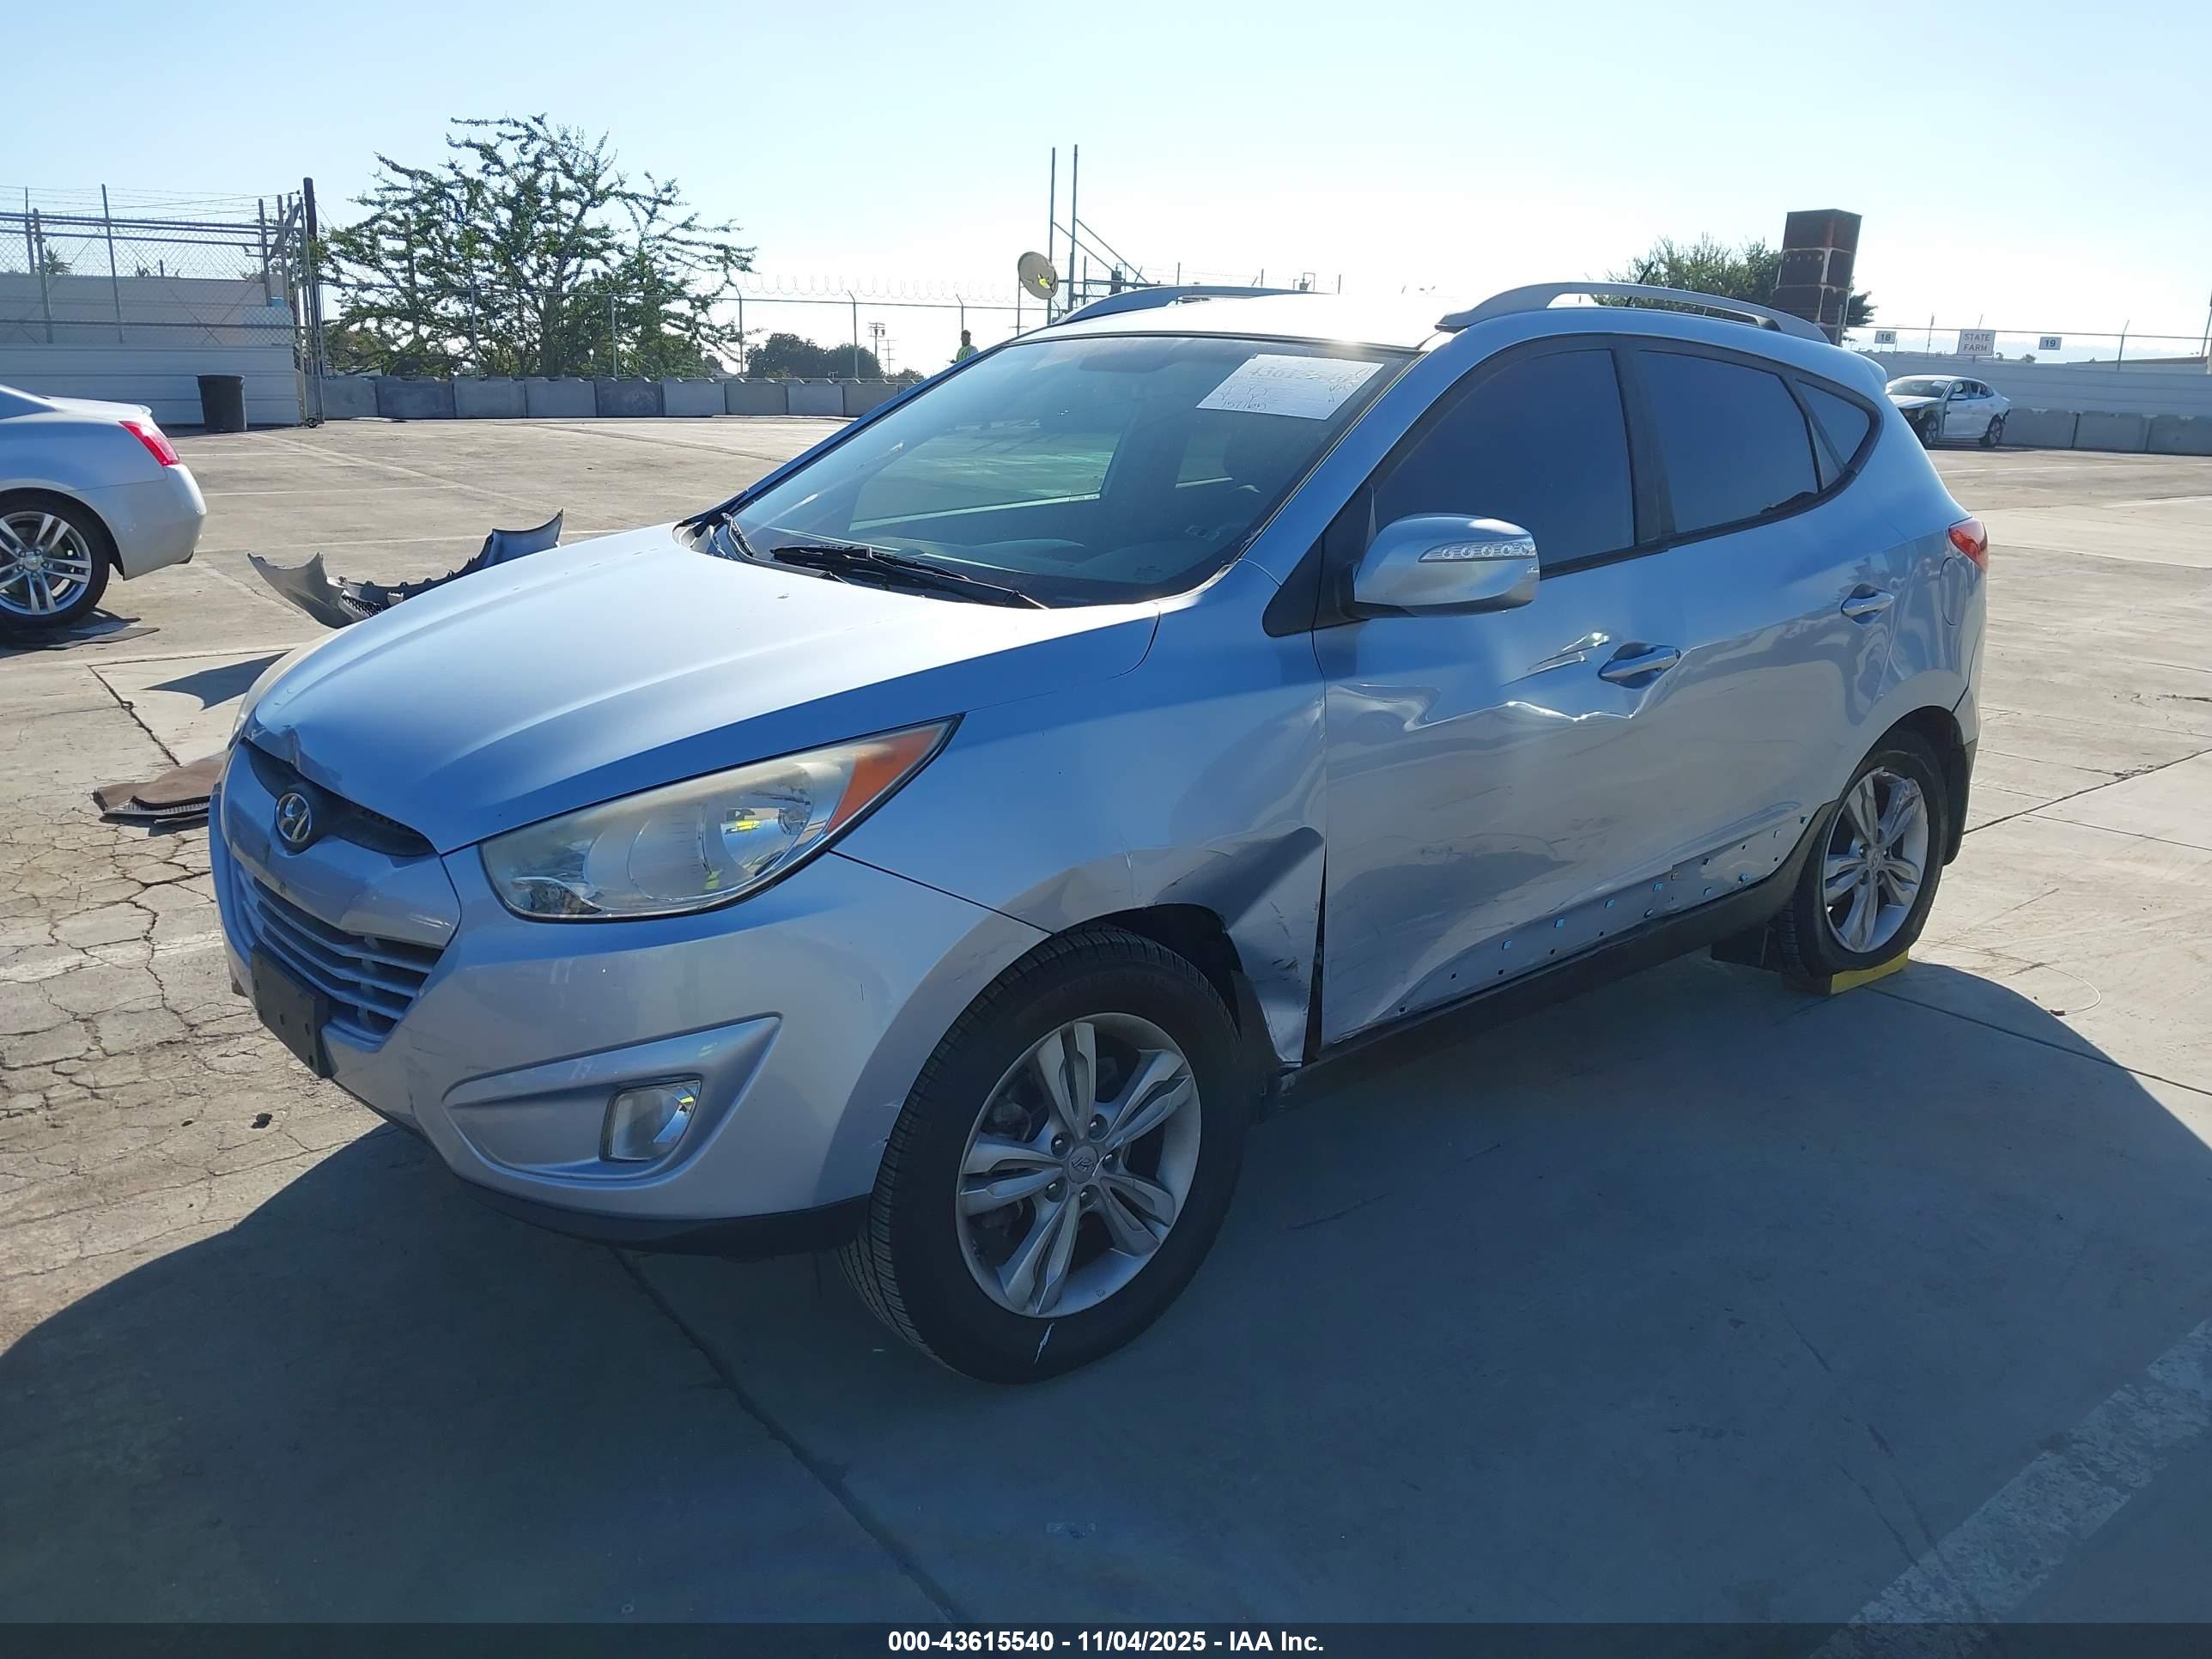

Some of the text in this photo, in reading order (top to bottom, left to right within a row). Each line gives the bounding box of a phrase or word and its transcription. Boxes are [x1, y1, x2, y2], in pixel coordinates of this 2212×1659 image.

[1881, 333, 1891, 342] 18
[1964, 333, 1990, 342] STATE
[1963, 343, 1987, 352] FARM
[2045, 339, 2056, 348] 19
